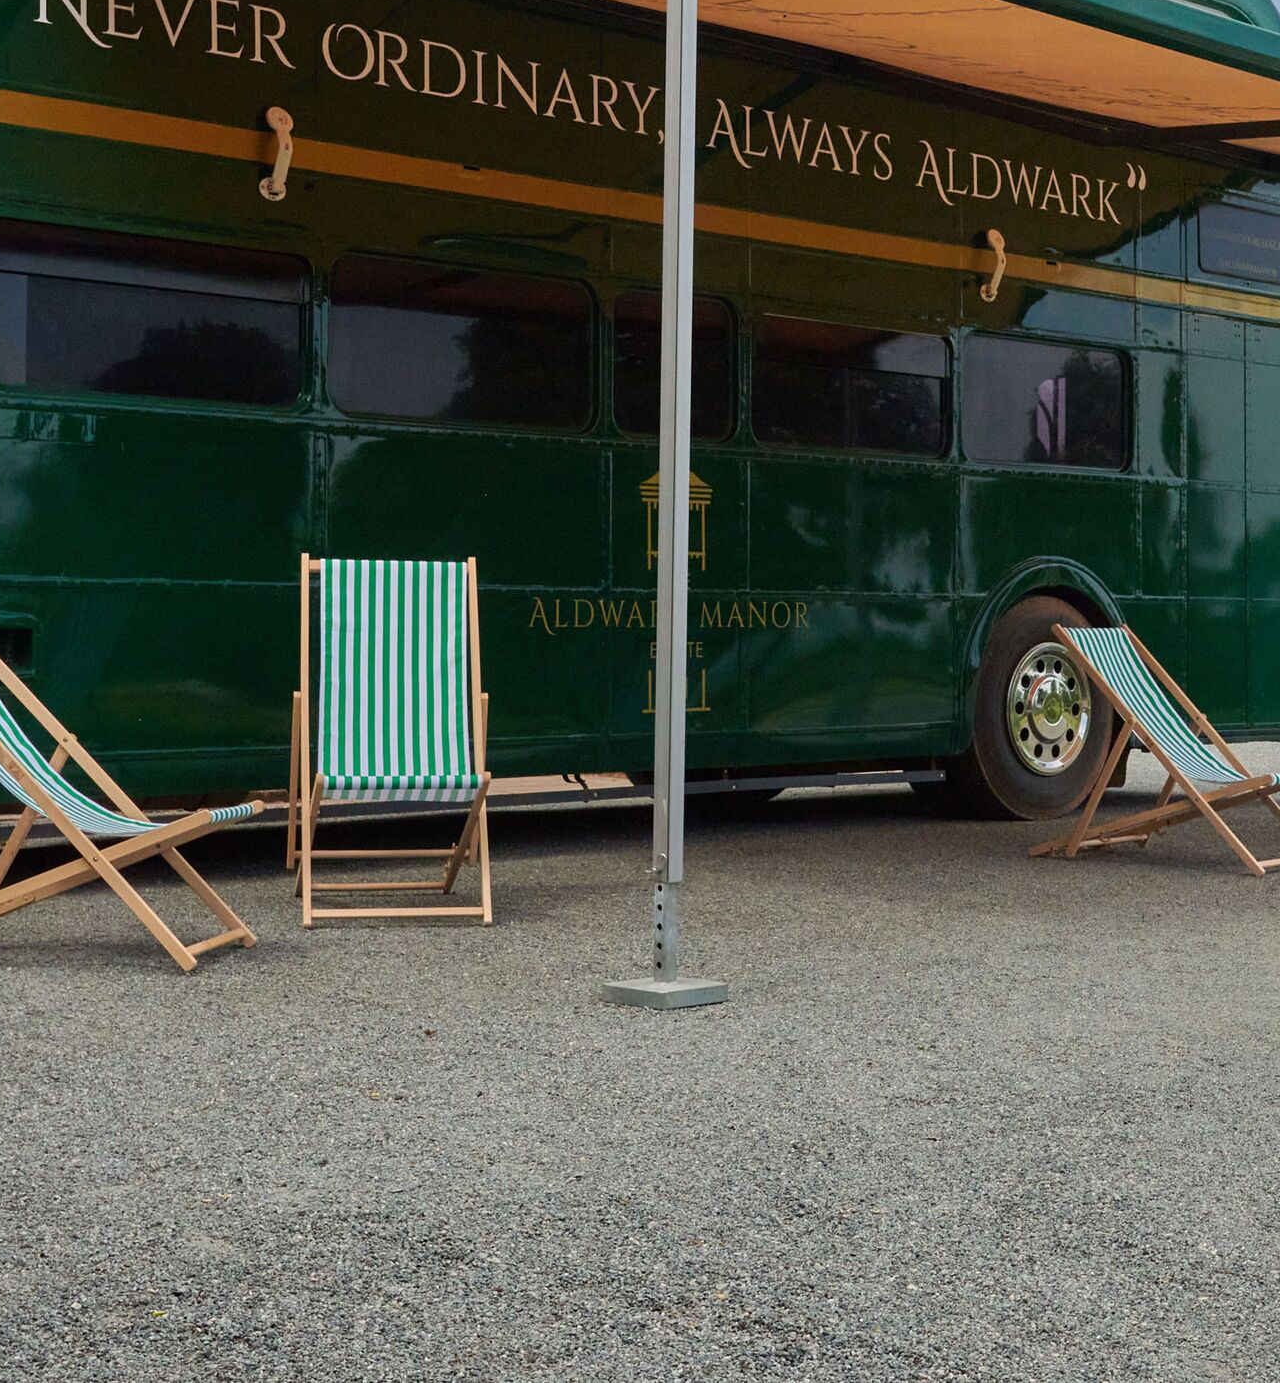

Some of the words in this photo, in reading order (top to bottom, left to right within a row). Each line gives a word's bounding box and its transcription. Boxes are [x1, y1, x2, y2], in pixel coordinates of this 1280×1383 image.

[322, 22, 665, 145] ORDINARY,
[705, 98, 893, 181] ALWAYS
[699, 600, 809, 629] MANOR
